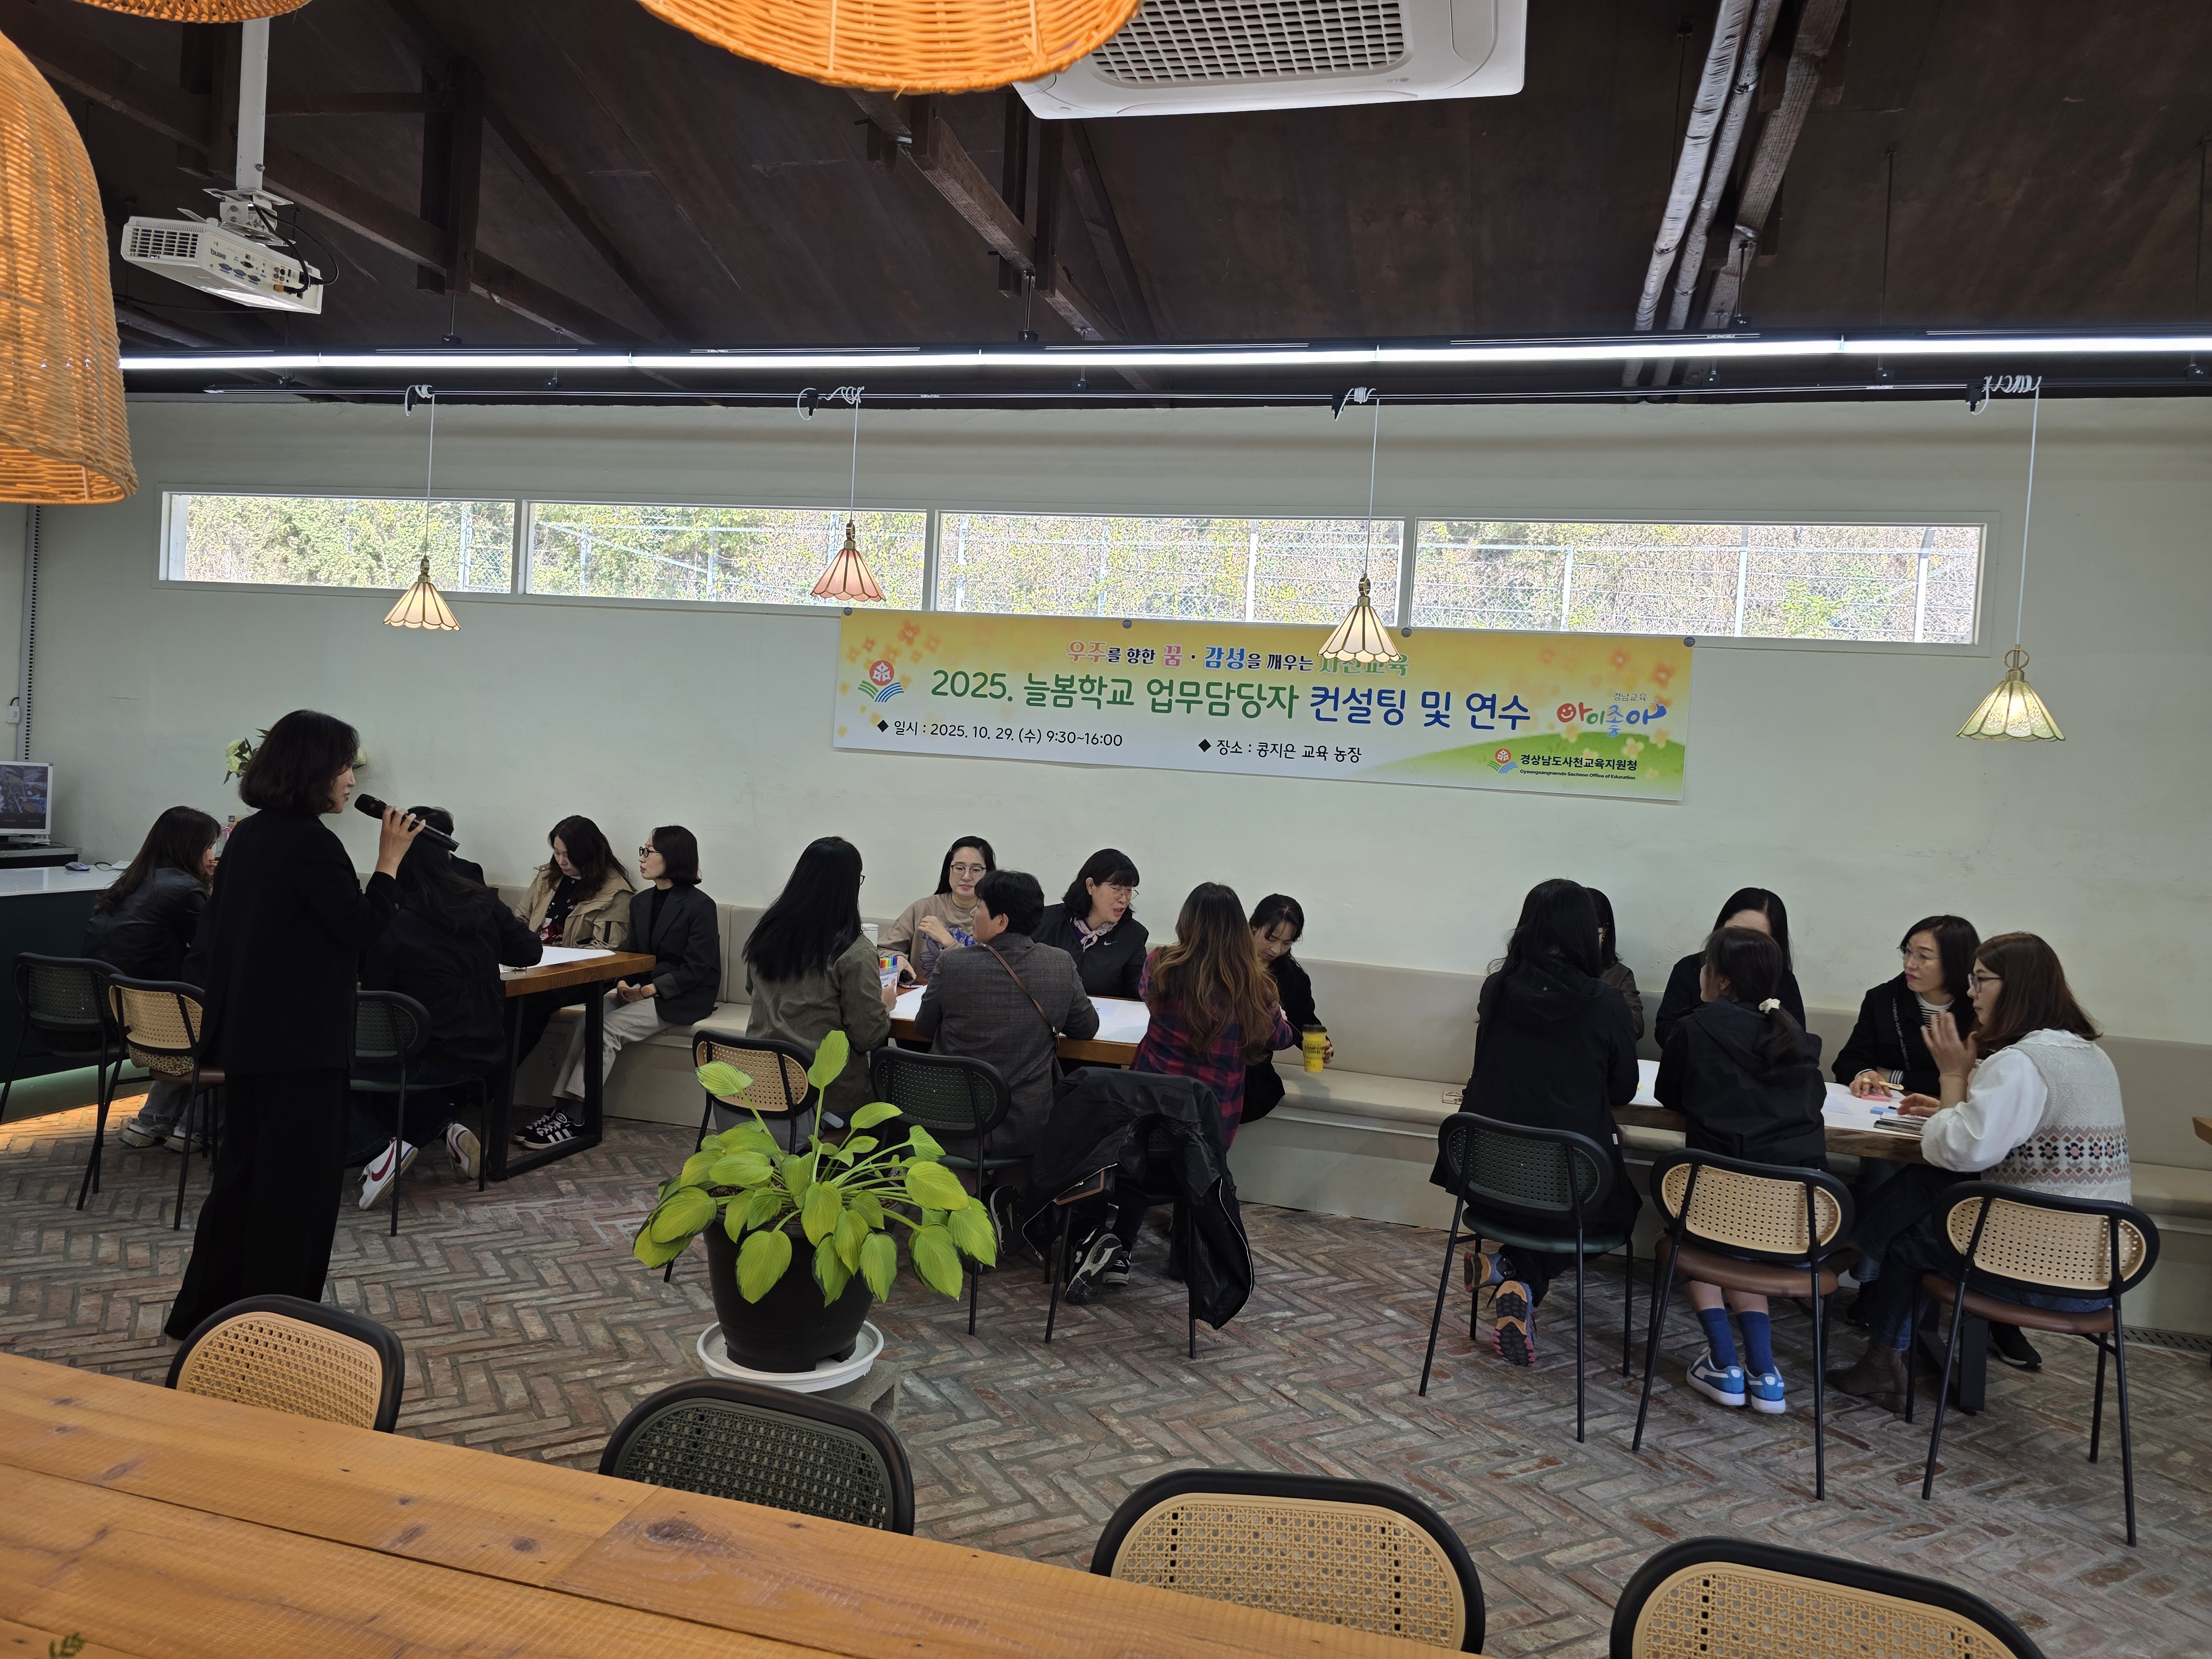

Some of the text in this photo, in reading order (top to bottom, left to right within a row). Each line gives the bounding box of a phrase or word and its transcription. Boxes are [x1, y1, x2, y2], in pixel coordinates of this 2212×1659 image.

[210, 248, 226, 260] BenQ
[1067, 641, 1121, 663] 우주를
[1127, 648, 1156, 664] 향한
[1163, 645, 1182, 667] 꿈
[1204, 647, 1261, 669] 감성을
[1267, 654, 1313, 671] 깨우는
[931, 670, 1531, 731] 2025. 늘봄학교 업무담당자 컨설팅 및 연수
[1613, 692, 1647, 702] 경남교육
[1557, 702, 1667, 737] 아이좋아
[894, 721, 918, 735] 일시
[930, 723, 968, 738] 2025.
[973, 726, 990, 739] 10.
[995, 727, 1014, 741] 29.
[1019, 728, 1042, 744] (수)
[1046, 731, 1123, 747] 9:30~16:00
[1217, 740, 1243, 755] 장소
[1256, 742, 1296, 759] 콩지은
[1302, 745, 1328, 761] 교육
[1334, 747, 1362, 763] 농장
[1520, 754, 1637, 771] 경상남도사천교육지원청
